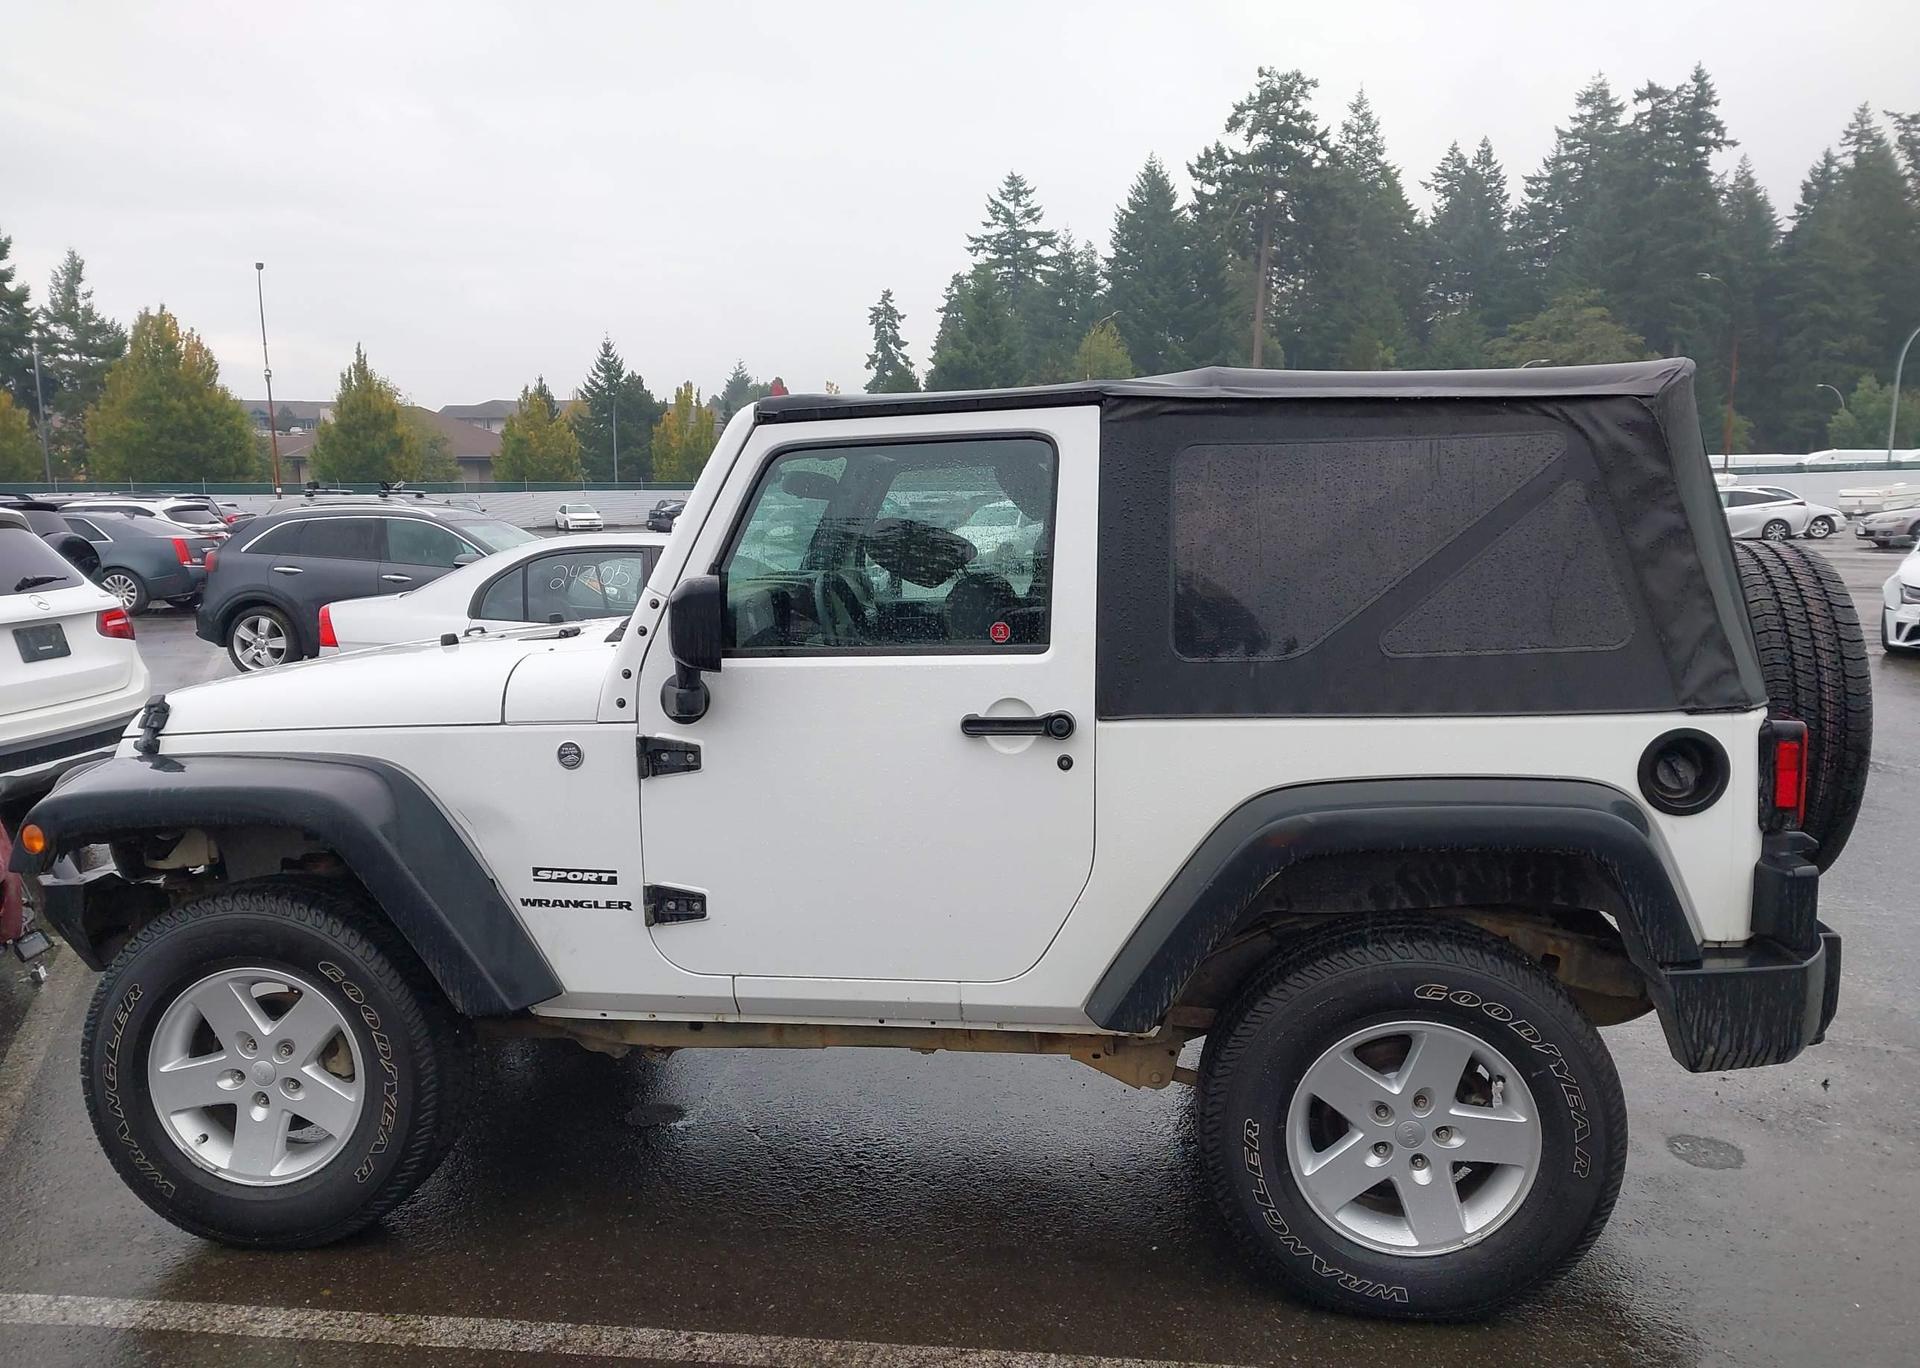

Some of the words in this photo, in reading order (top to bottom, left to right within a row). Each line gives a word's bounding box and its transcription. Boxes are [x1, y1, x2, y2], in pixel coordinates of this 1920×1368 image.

[550, 565, 630, 591] 24705
[520, 898, 633, 911] WRANGLER
[535, 869, 617, 883] SPORT
[102, 983, 176, 1198] WRANGLER
[318, 961, 398, 1184] GOODYEAR
[1414, 984, 1591, 1179] GOODYEAR
[1243, 1118, 1409, 1303] WRANGLER
